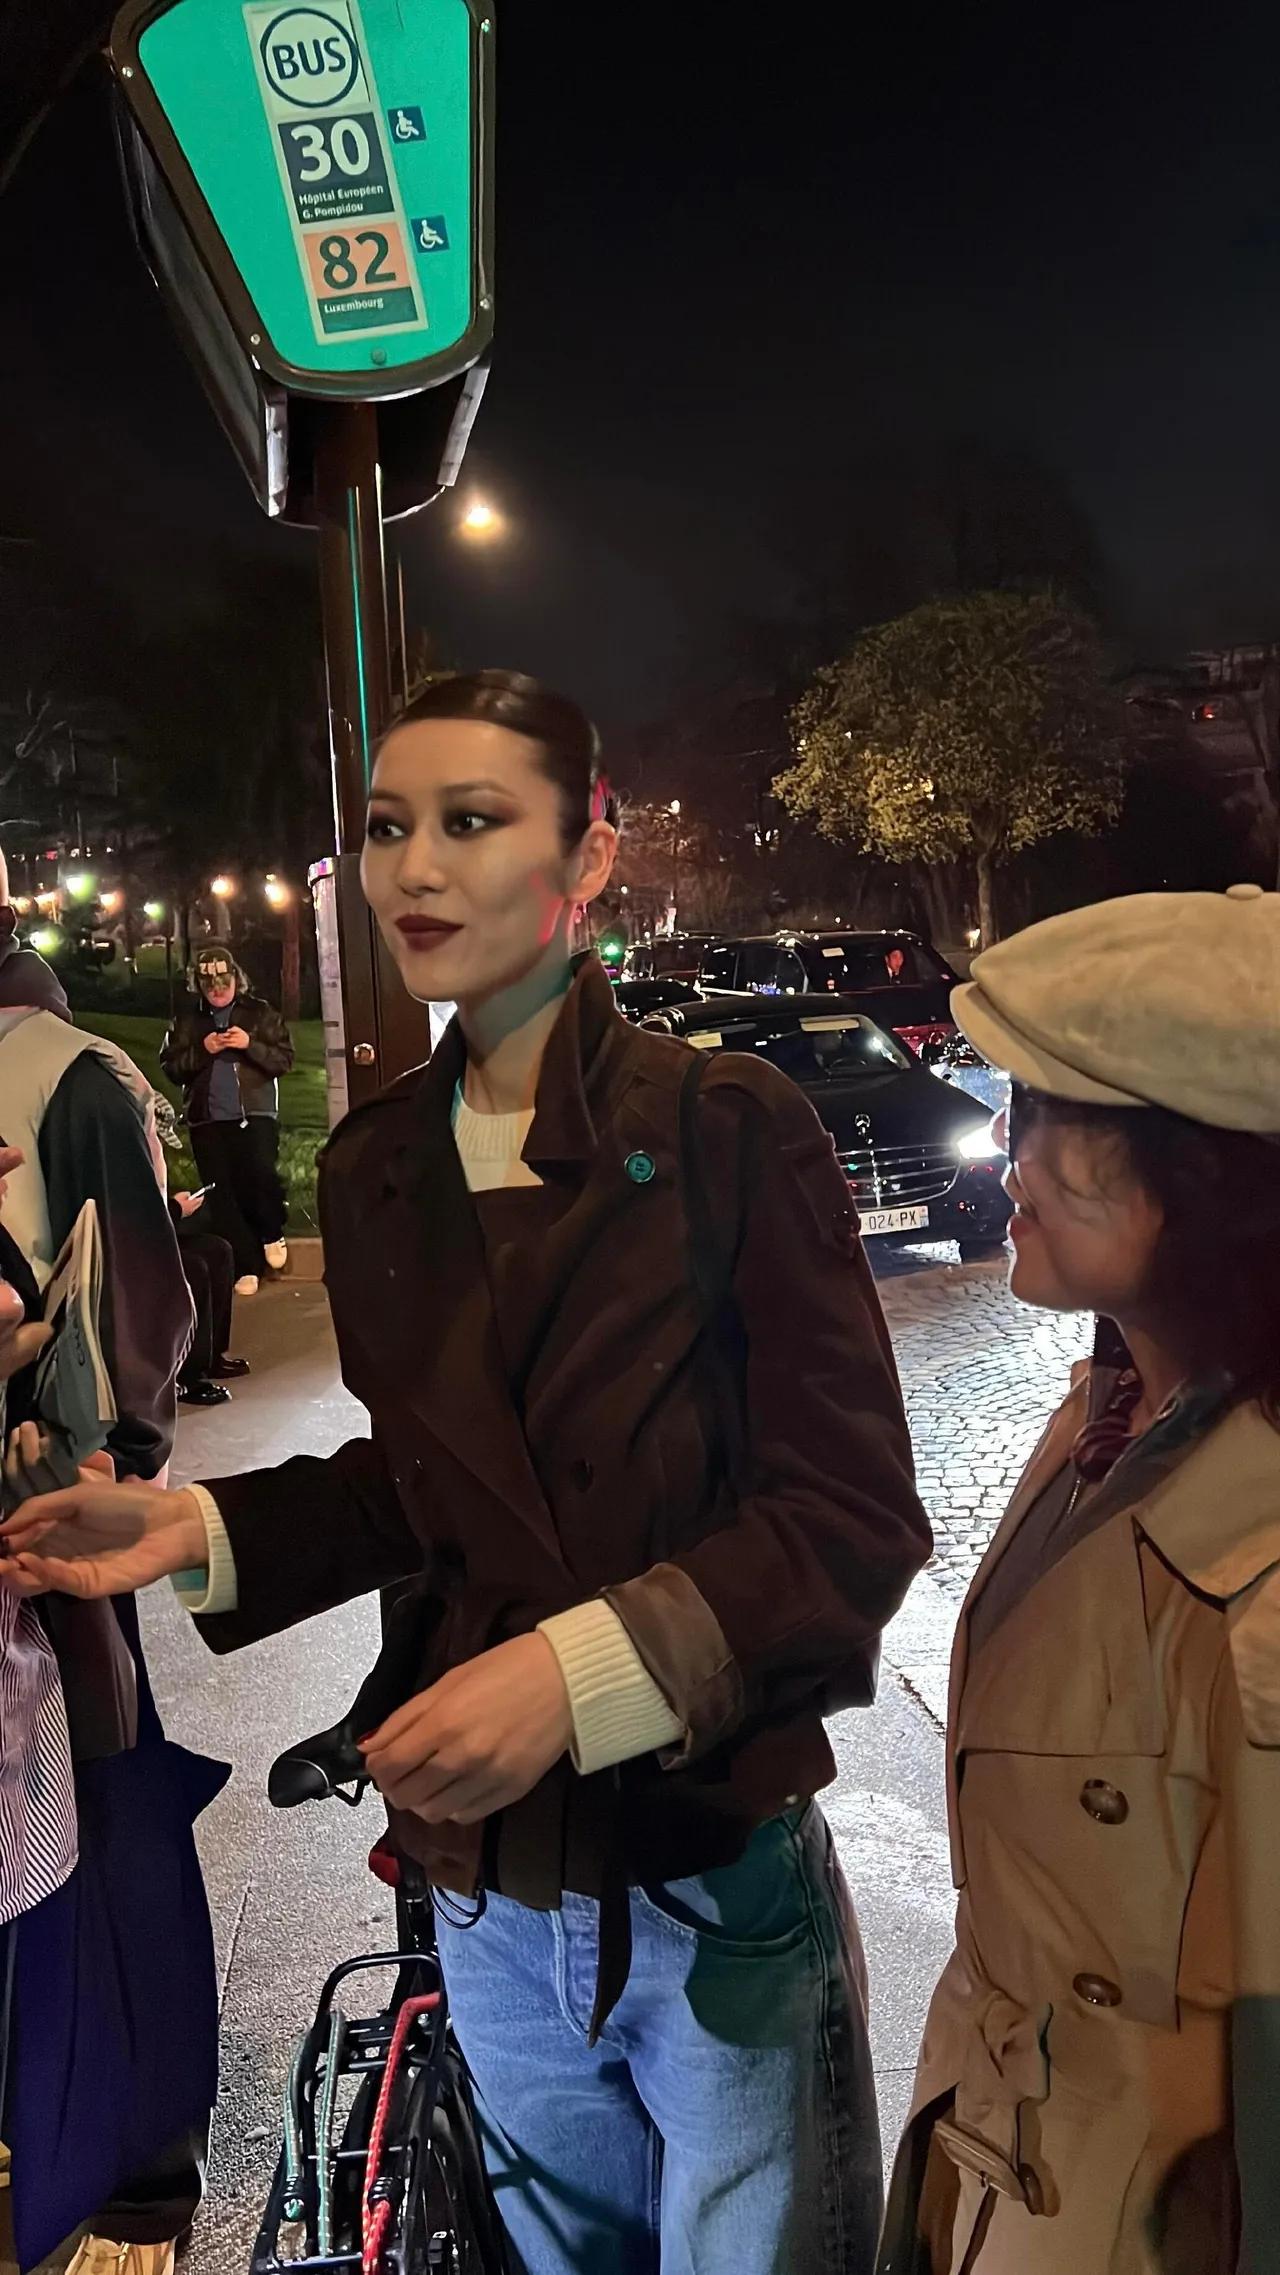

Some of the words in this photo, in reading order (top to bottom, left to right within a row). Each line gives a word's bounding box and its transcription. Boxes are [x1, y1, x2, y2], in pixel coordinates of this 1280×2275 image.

[272, 37, 346, 80] BUS
[291, 118, 370, 182] 30
[299, 189, 335, 206] Hôpital
[302, 208, 313, 219] G.
[314, 203, 363, 217] Pompidou
[319, 231, 397, 290] 82
[324, 298, 384, 314] Luxembourg
